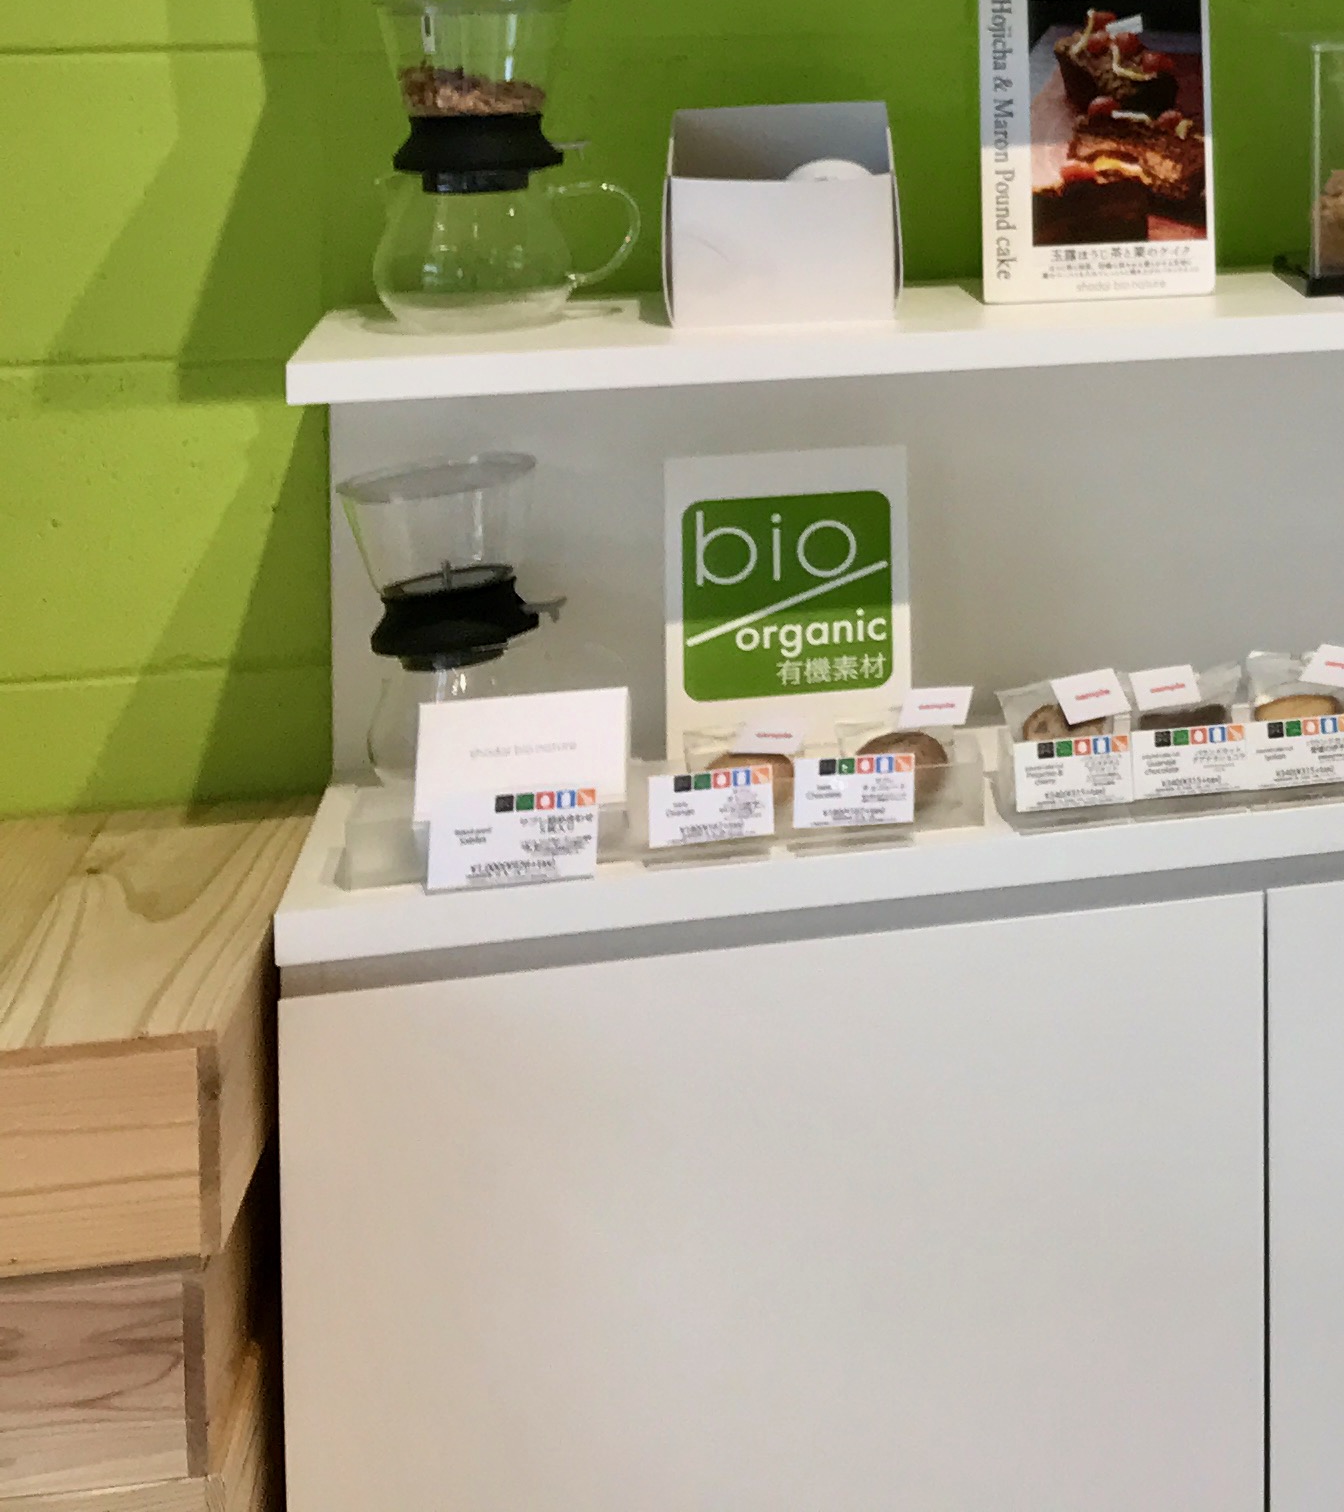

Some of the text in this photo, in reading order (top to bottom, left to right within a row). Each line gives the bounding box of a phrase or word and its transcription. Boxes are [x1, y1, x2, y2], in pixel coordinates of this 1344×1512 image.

[992, 76, 1013, 93] &
[993, 97, 1015, 164] Maron
[994, 169, 1017, 231] Pound
[996, 236, 1018, 280] cake
[695, 509, 857, 587] bio
[735, 607, 888, 659] organic
[776, 652, 888, 687] 有機素材
